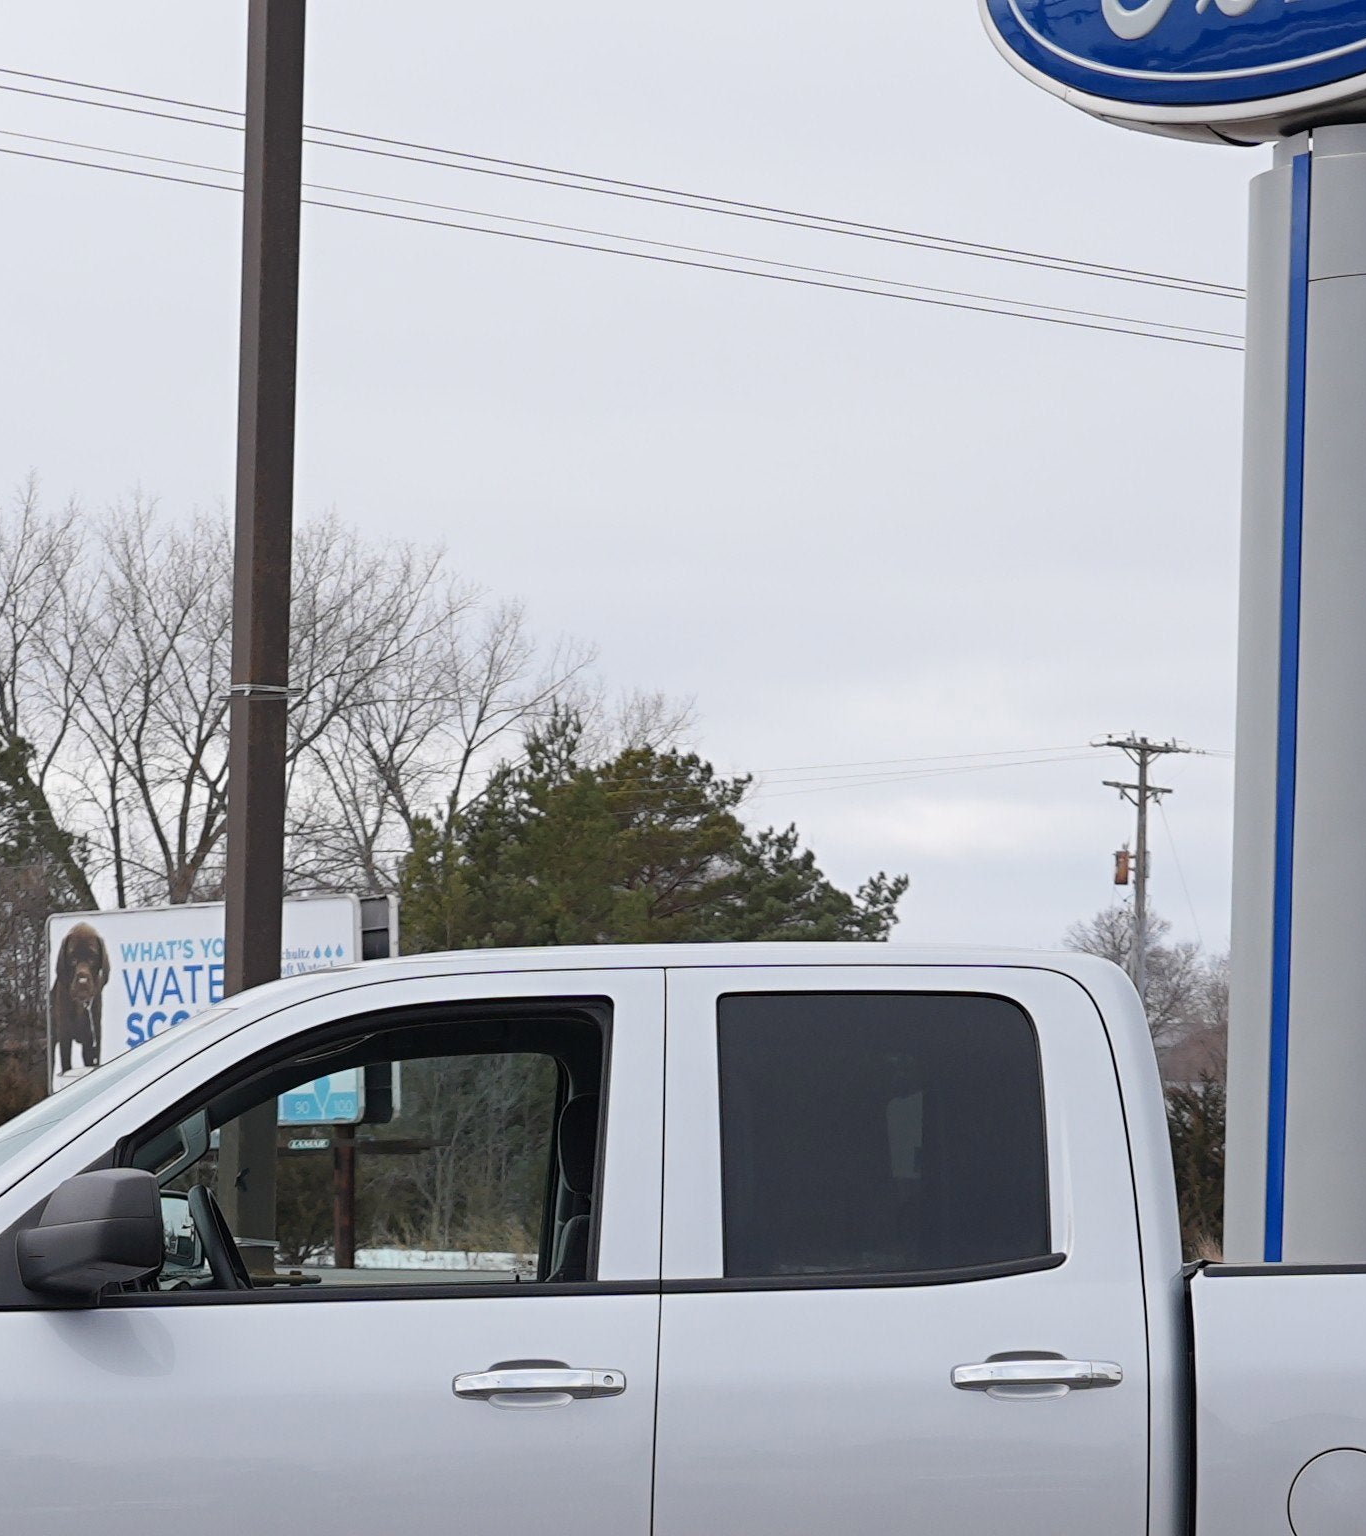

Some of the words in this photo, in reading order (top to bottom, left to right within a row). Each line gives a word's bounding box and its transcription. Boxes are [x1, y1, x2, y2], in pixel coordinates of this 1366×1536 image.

[120, 939, 194, 962] WHAT'S
[200, 937, 224, 958] YO
[282, 948, 310, 960] hultz
[122, 964, 224, 1007] WATE
